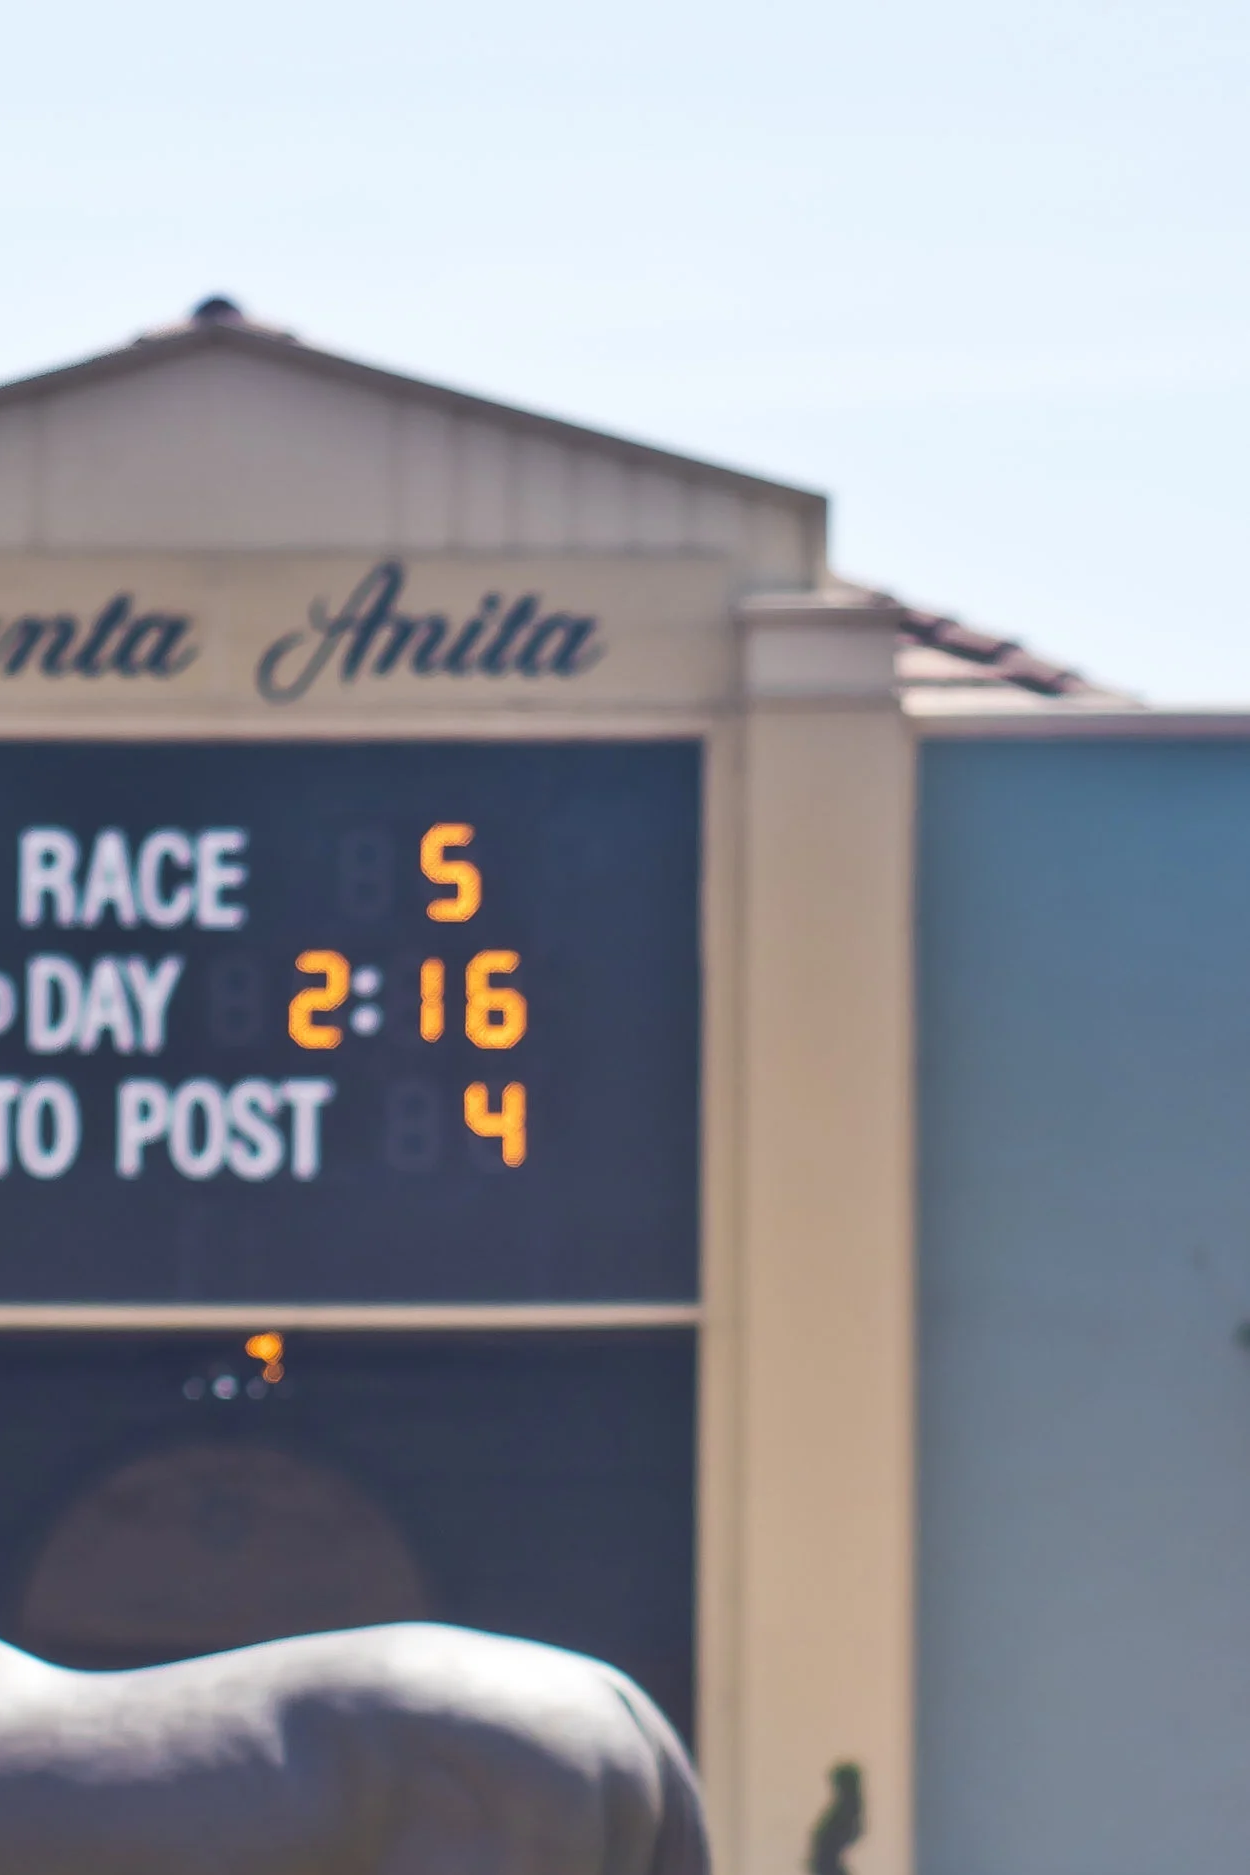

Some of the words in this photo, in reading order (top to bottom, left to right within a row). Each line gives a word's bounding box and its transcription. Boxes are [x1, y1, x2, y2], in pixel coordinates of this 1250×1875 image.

[253, 554, 608, 705] Anita
[17, 826, 248, 930] RACE
[419, 822, 483, 922] 5
[27, 953, 183, 1053] DAY
[116, 1078, 335, 1180] POST
[463, 1082, 528, 1167] 4
